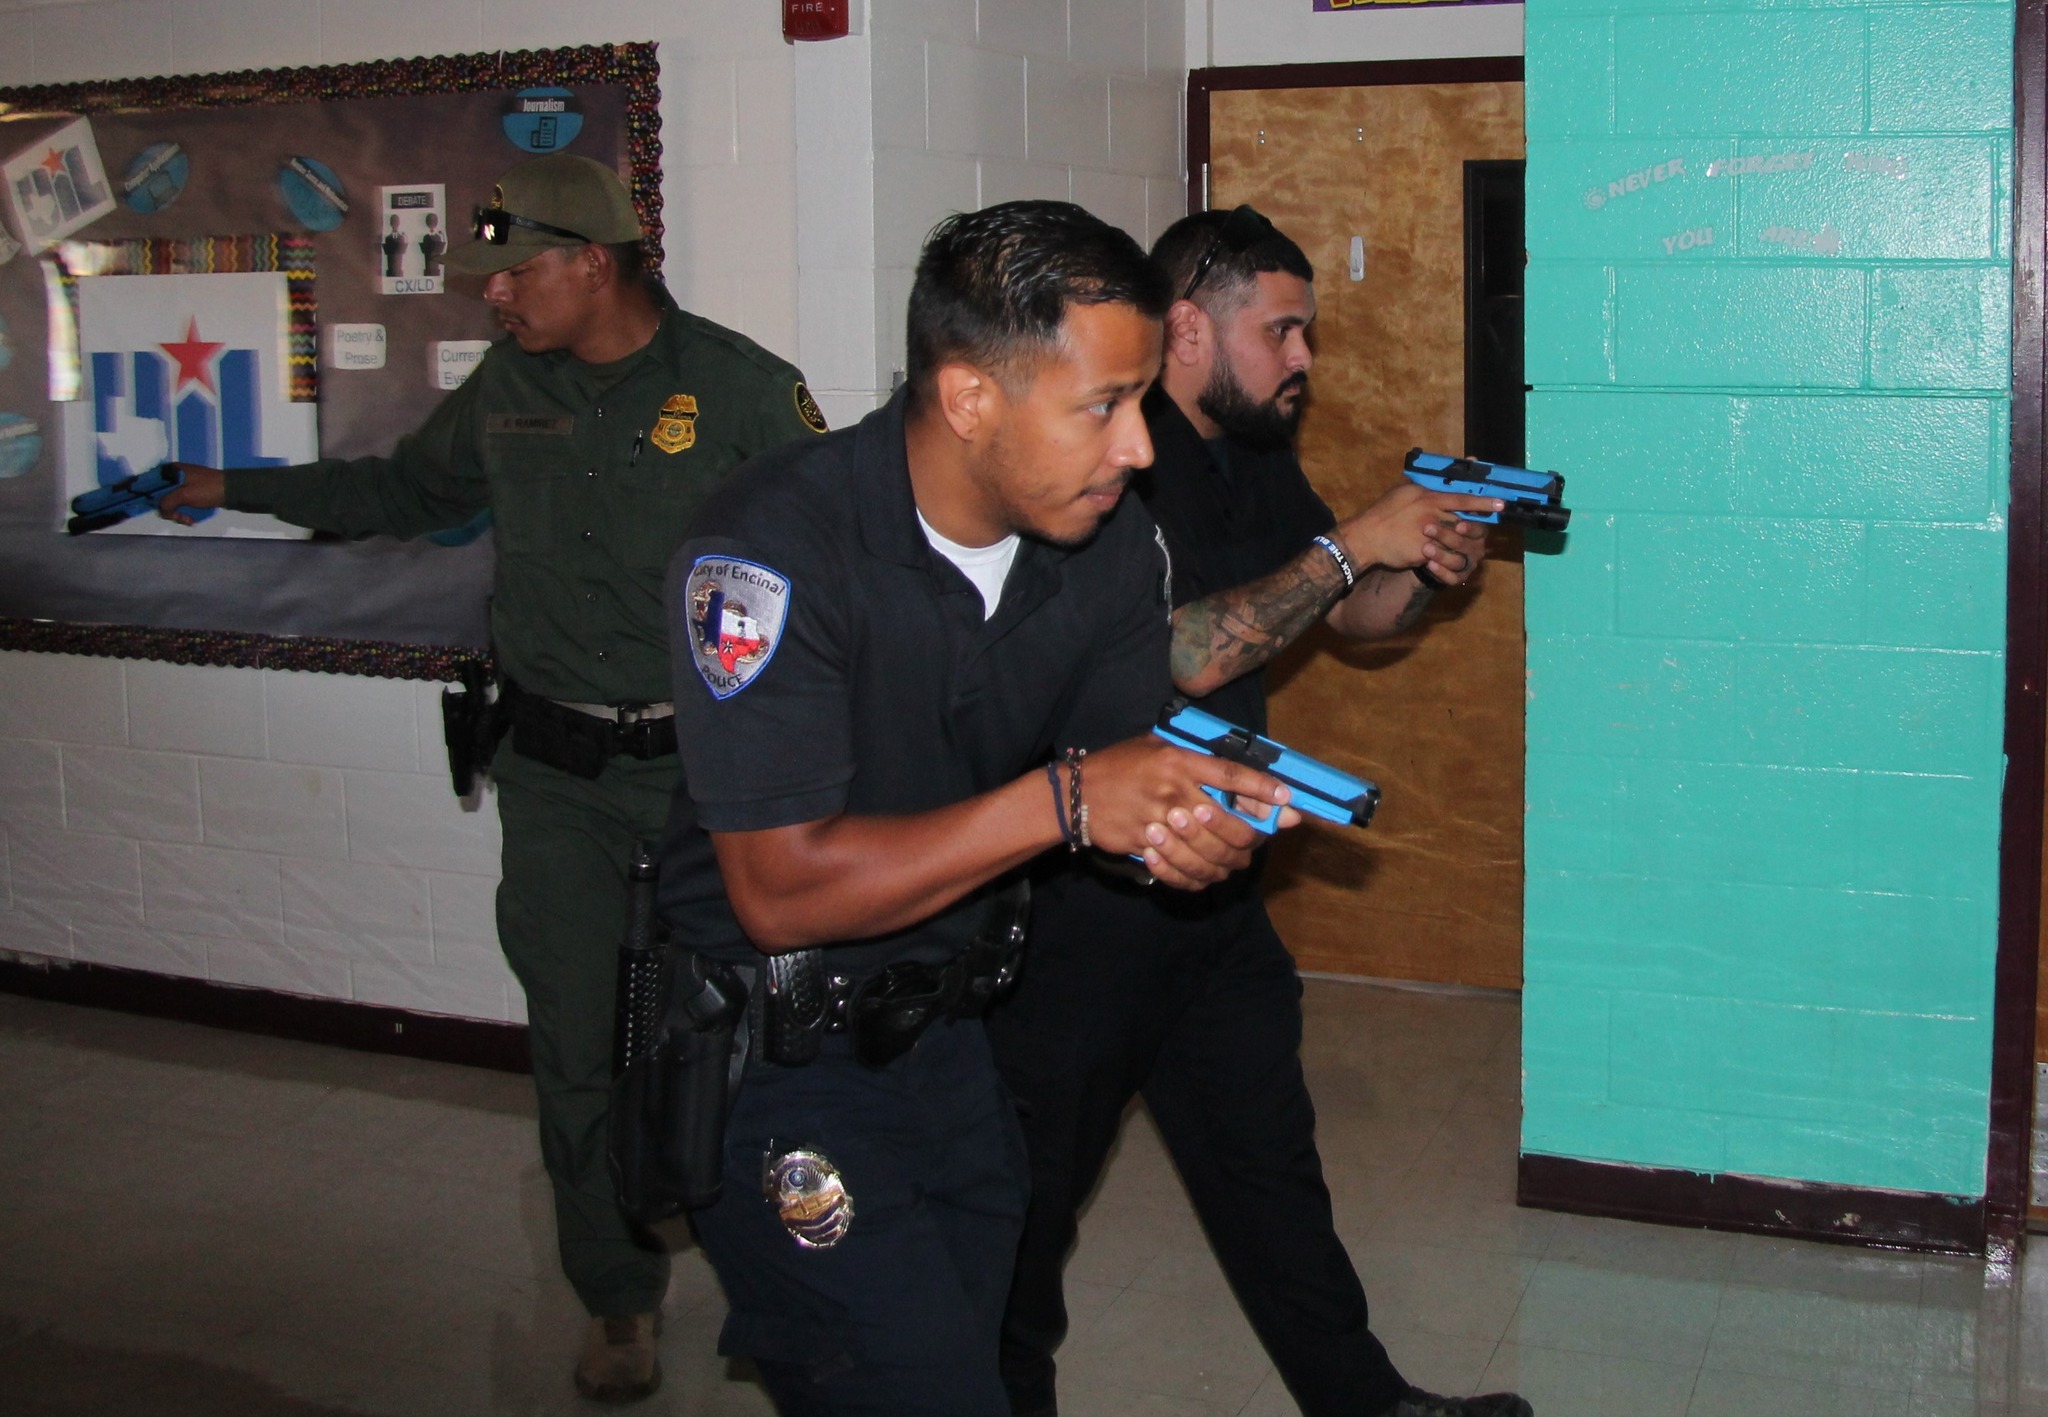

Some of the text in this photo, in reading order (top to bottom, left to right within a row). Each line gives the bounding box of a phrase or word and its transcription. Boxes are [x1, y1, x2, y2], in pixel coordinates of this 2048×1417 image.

[791, 3, 823, 14] FIRE
[523, 98, 565, 112] Journalism
[1608, 158, 1686, 198] NEVER
[397, 195, 427, 207] DEBATE
[1661, 227, 1714, 255] YOU
[395, 278, 435, 293] CX/LD
[336, 329, 385, 345] Poetry &
[344, 352, 378, 365] Prose
[444, 372, 468, 385] Eve
[1328, 543, 1344, 563] THE
[715, 563, 729, 577] of
[731, 565, 785, 597] Encinal
[1341, 562, 1354, 585] BACK
